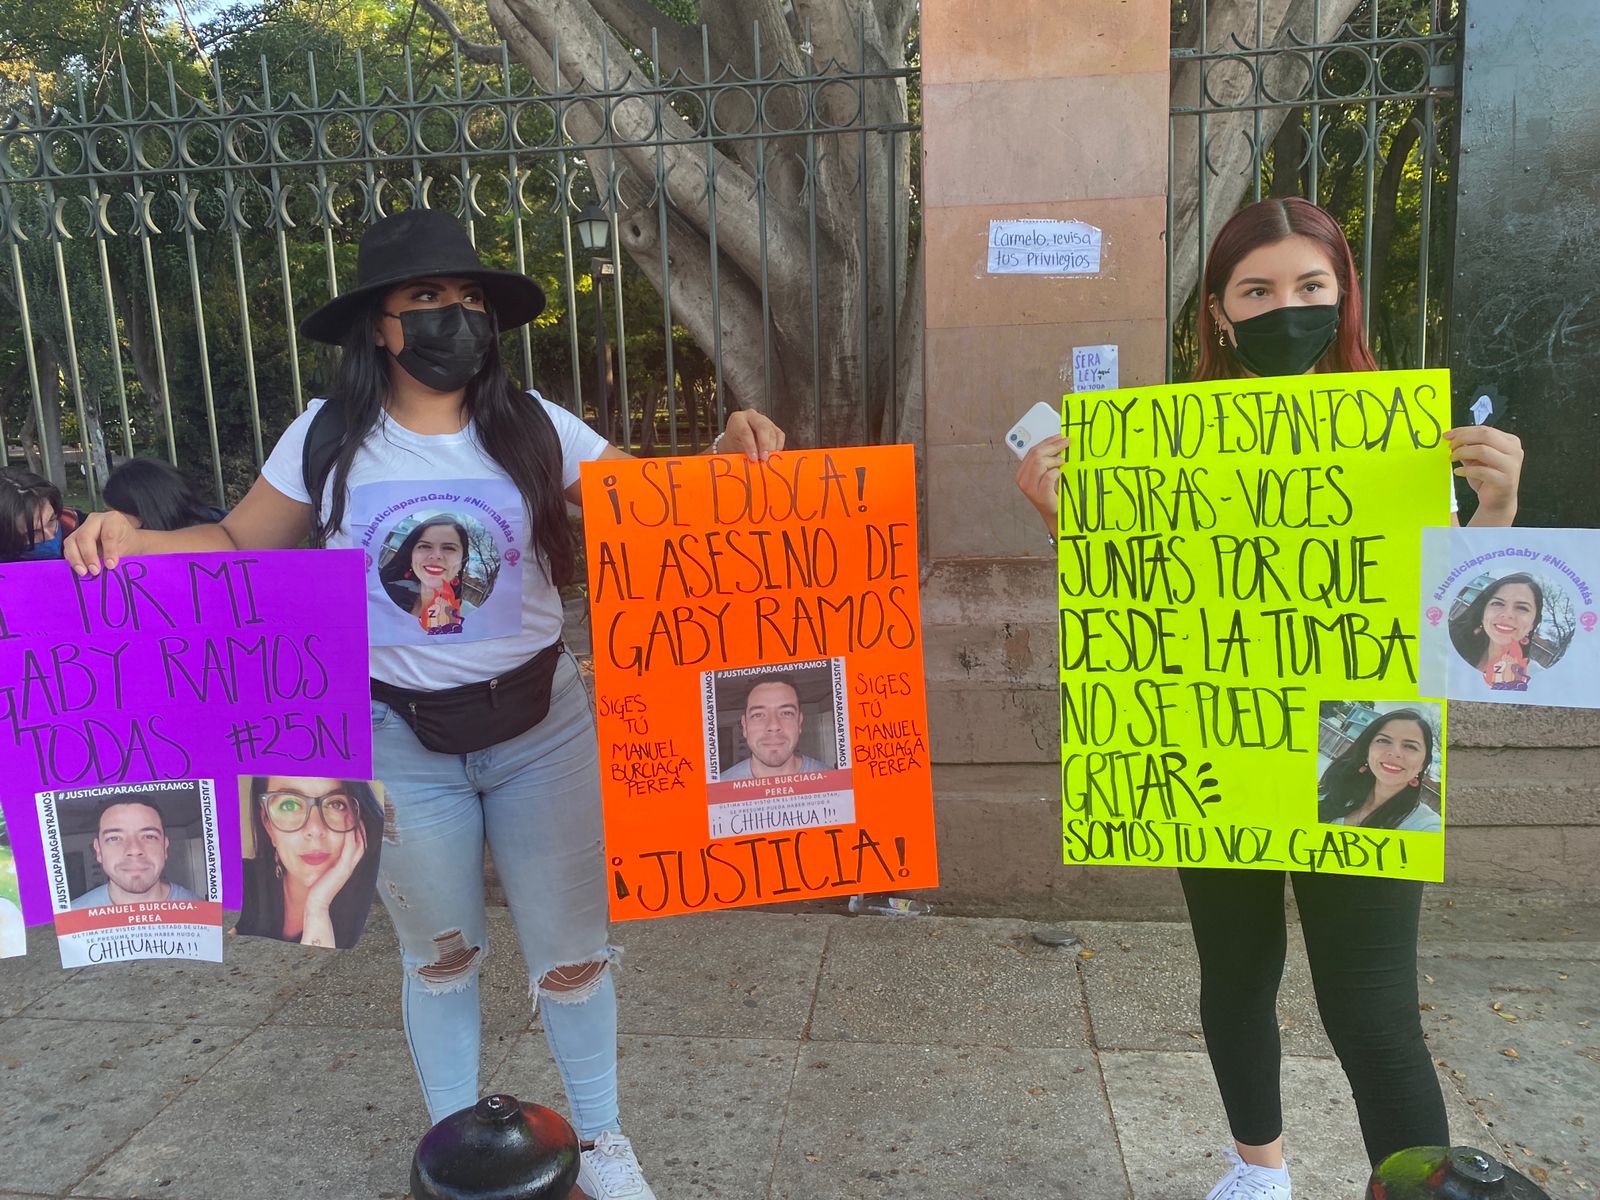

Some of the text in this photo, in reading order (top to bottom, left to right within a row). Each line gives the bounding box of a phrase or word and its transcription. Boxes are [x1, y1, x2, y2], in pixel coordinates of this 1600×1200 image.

[994, 225, 1092, 247] Carmelo, revisa
[994, 250, 1020, 267] tus
[1078, 368, 1098, 383] LEY
[1236, 465, 1353, 528] VOCES
[361, 493, 461, 548] #JusticiaparaGaby
[595, 523, 909, 604] AL ASESINO DE
[1060, 533, 1387, 608] JUNTAS POR QUE
[1433, 547, 1540, 601] #JusticiaparaGaby
[71, 561, 176, 634] POR
[609, 586, 916, 677] GABY RAMOS
[1200, 607, 1250, 678] LA
[1261, 608, 1416, 684] TUMBA
[159, 634, 329, 705] RAMOS
[717, 660, 827, 679] #JUSTICIAPARAGABYRAMOS
[855, 672, 911, 699] SIGES
[600, 694, 647, 719] SIGES
[833, 658, 847, 767] #JUSTICIAPARAGABYRAMOS
[858, 698, 882, 718] TÚ
[1061, 678, 1309, 753] NO SE PUEDE
[623, 715, 648, 735] TÚ
[705, 670, 718, 780] #JUSTICIAPARAGABYRAMOS
[855, 720, 922, 741] MANUEL
[18, 715, 191, 785] TODAS
[612, 739, 679, 761] MANUEL
[854, 737, 925, 762] BURCIAGA
[611, 757, 693, 782] BURCIAGA
[868, 757, 922, 779] PEREA
[58, 782, 195, 801] #JUSTICIAPARAGABYRAMOS
[624, 777, 686, 798] PEREA
[733, 772, 828, 790] MANUEL BURCIAGA-
[765, 787, 794, 797] PEREA
[1064, 750, 1207, 825] GRITAR
[42, 792, 68, 909] #JUSTICIAPARAGABYRAMOS
[201, 780, 218, 900] #JUSTICIAPARAGABYRAMOS
[1163, 821, 1207, 863] TU
[1214, 825, 1284, 864] VOZ
[1289, 828, 1407, 872] GABY!
[88, 902, 198, 918] MANUEL BURCIAGA-
[128, 914, 162, 924] PEREA
[97, 934, 129, 942] PRESUME
